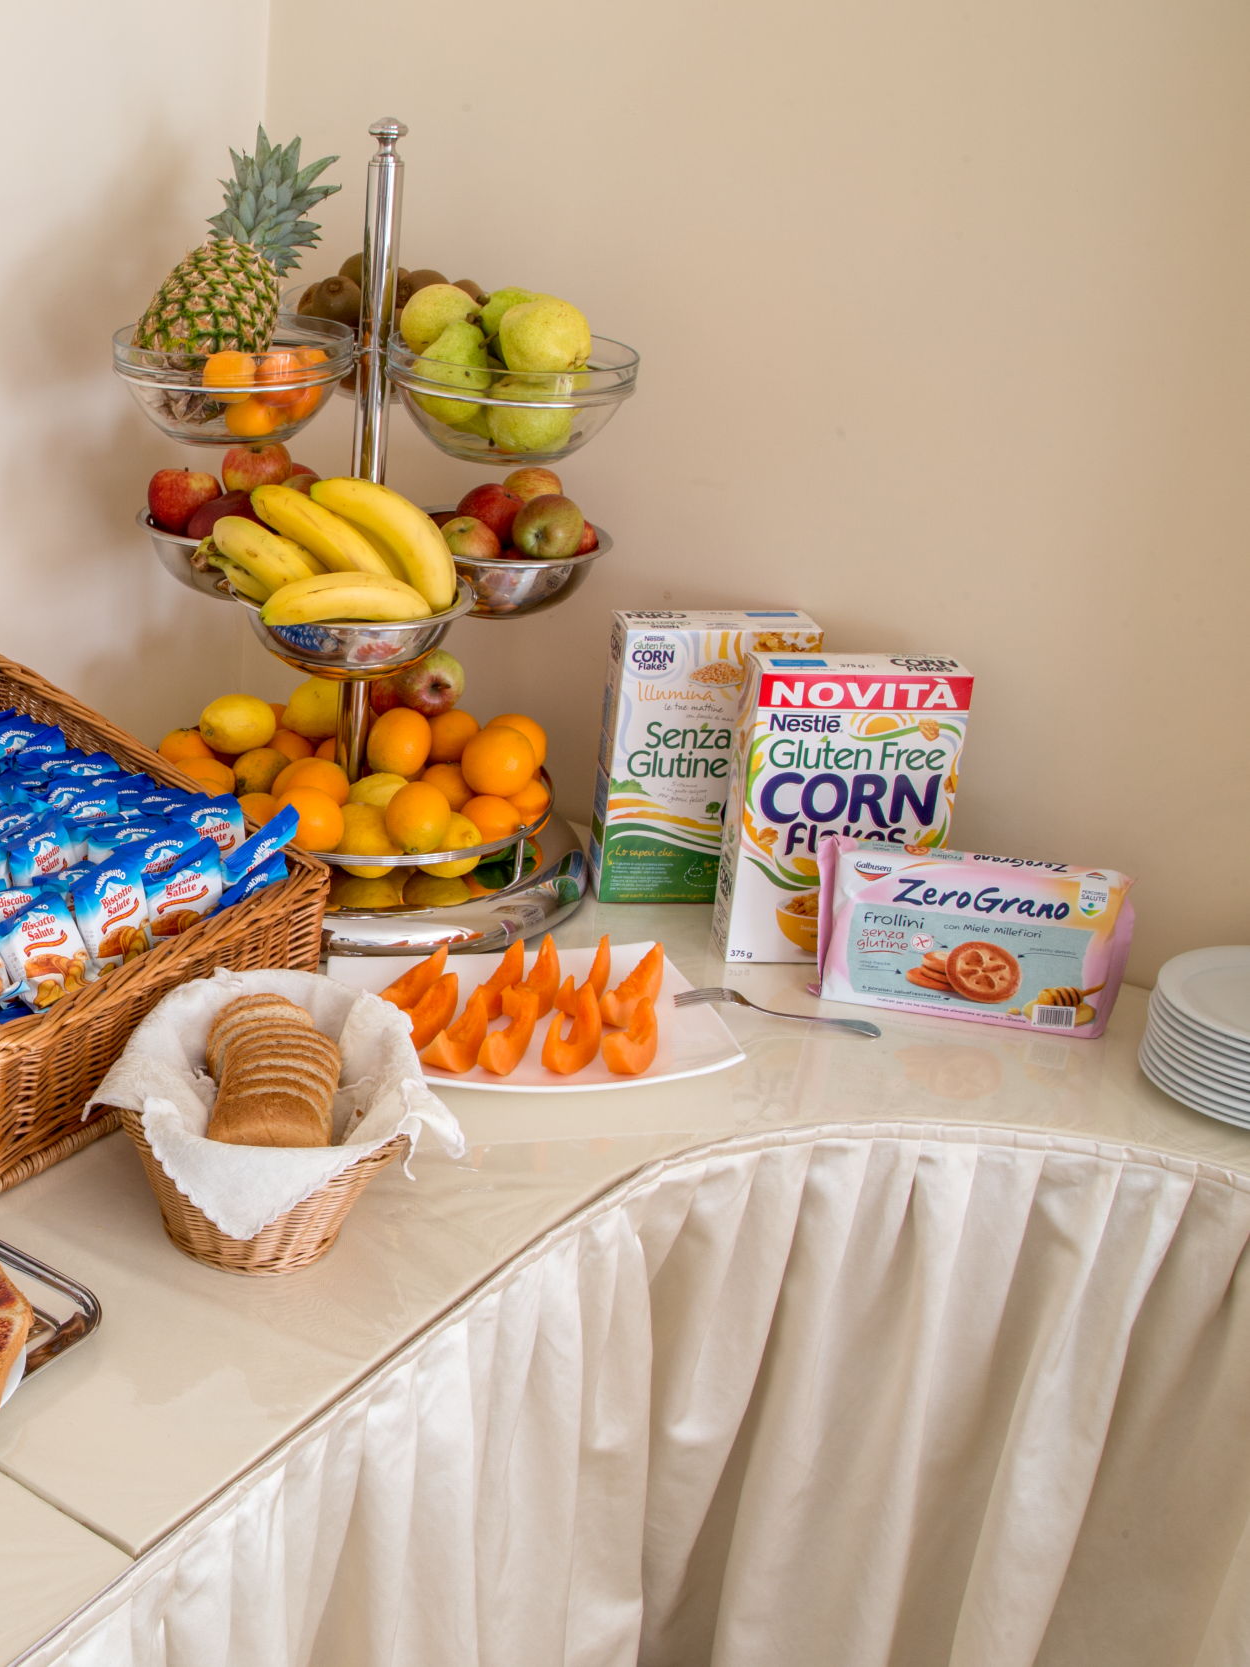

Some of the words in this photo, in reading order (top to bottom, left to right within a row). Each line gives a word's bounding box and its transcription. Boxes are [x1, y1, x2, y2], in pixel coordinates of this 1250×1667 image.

[633, 642, 659, 650] Gluten
[659, 642, 676, 650] Free
[632, 650, 675, 663] CORN
[890, 658, 959, 668] CORN
[637, 680, 716, 702] Illumina
[770, 678, 958, 709] NOVITÀ
[769, 713, 842, 733] Nestlé
[645, 722, 732, 749] Senza
[769, 738, 874, 770] Gluten
[879, 741, 947, 771] Free
[627, 750, 729, 778] Glutine
[760, 771, 943, 829] CORN
[196, 821, 230, 836] Biscotto
[784, 821, 907, 856] fls
[34, 845, 60, 867] Biscotto
[41, 857, 60, 875] Salute
[855, 860, 892, 873] Galbusera
[165, 873, 202, 893] Biscotto
[166, 883, 197, 899] Salute
[100, 885, 132, 910] Biscotto
[892, 878, 1070, 920] ZeroGrano
[1081, 894, 1107, 903] SALUTE
[107, 898, 131, 917] Salute
[21, 915, 56, 933] Biscotto
[863, 911, 925, 929] Frollini
[27, 927, 55, 942] Salute
[861, 928, 905, 939] senza
[962, 923, 991, 934] Miele
[993, 927, 1043, 939] Millefiori
[856, 937, 909, 950] glutine
[730, 949, 746, 958] 375
[746, 951, 753, 959] g
